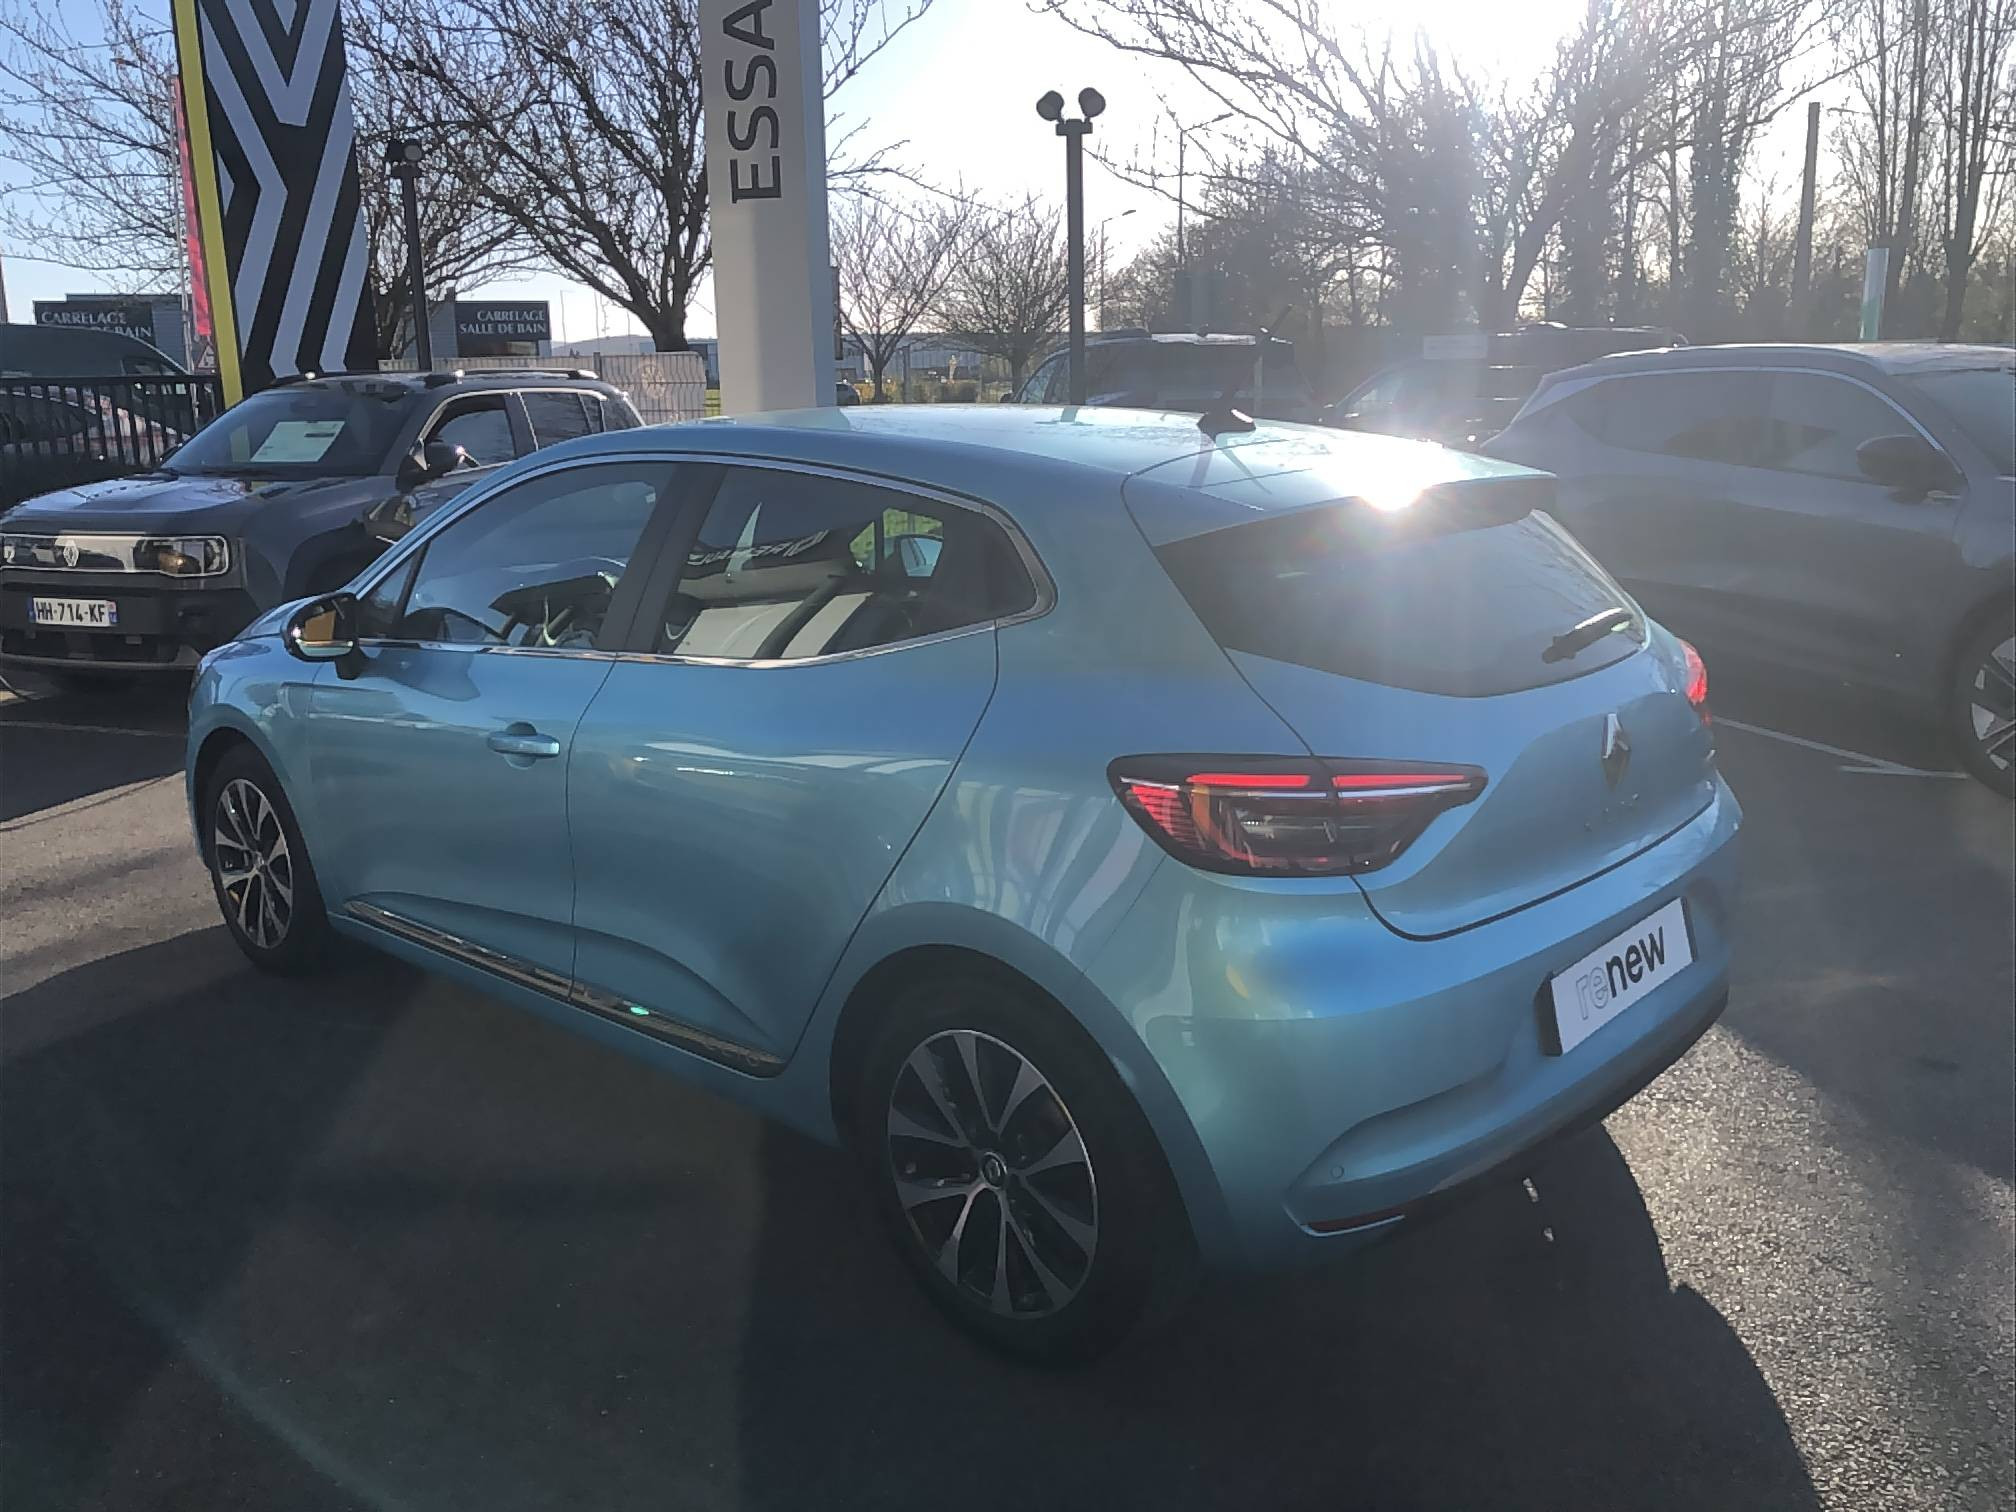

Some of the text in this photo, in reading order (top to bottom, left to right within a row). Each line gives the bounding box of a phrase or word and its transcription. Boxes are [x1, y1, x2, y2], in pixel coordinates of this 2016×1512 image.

[41, 311, 127, 324] CARRELAGE
[477, 310, 545, 321] CARRELAGE
[460, 323, 547, 334] SALLE DE BAIN
[35, 601, 105, 622] HH-714-KF
[1576, 926, 1665, 1020] renew
